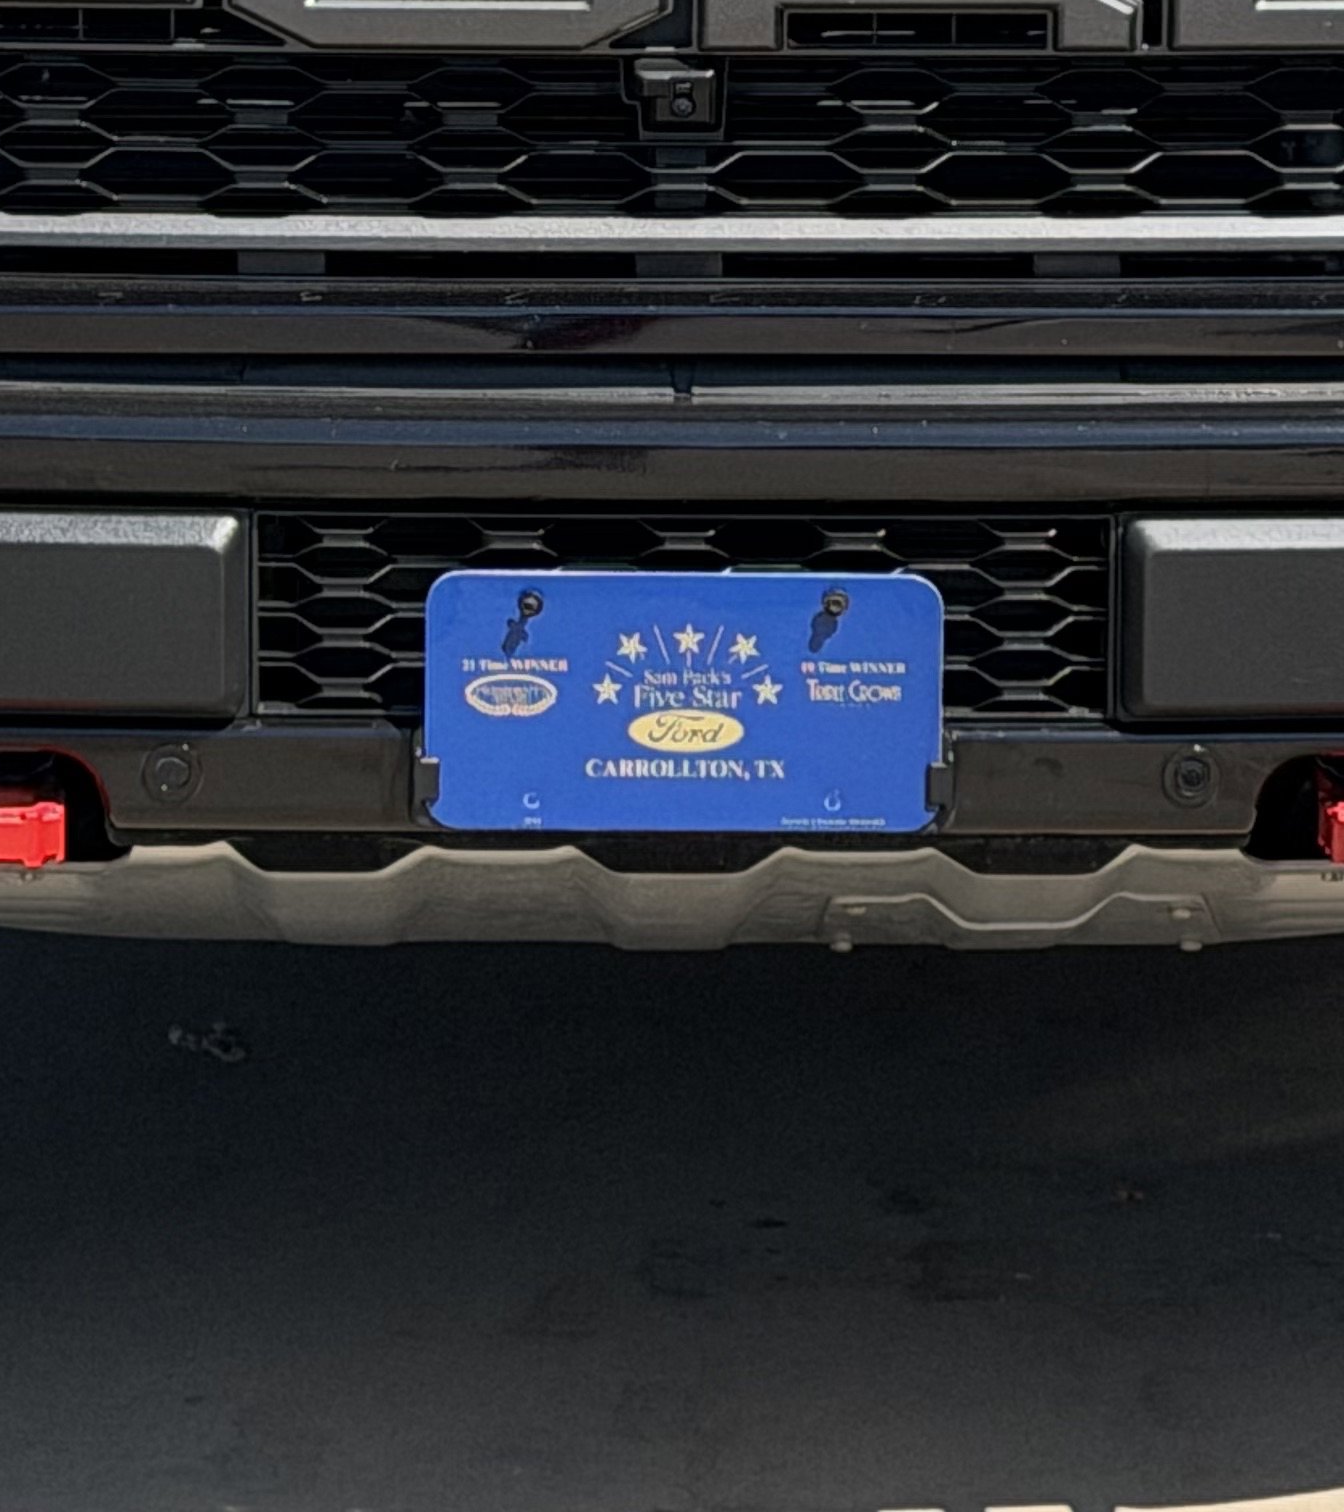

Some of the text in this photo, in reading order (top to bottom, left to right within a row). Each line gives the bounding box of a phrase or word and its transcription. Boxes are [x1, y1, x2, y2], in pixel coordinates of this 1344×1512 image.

[510, 658, 568, 672] WINNER
[849, 661, 906, 674] WINNER
[634, 684, 743, 709] Five Star
[647, 713, 725, 743] Ford
[585, 758, 785, 781] CARROLLTON, TX
